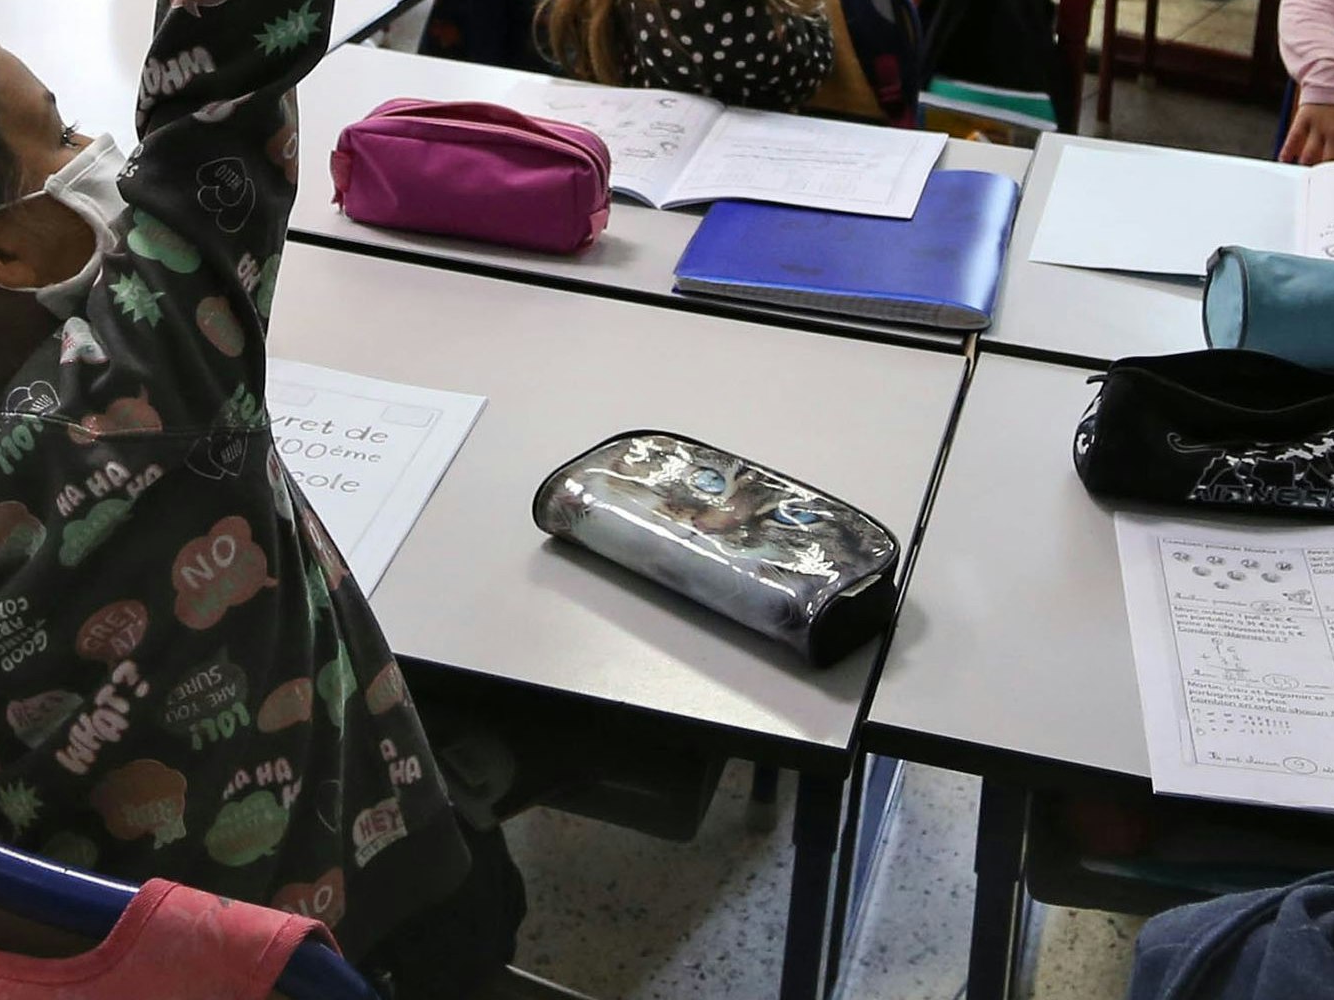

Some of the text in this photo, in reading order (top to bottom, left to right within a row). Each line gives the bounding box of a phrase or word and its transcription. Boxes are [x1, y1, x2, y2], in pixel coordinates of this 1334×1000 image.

[345, 425, 388, 444] de
[180, 534, 236, 590] NO
[255, 757, 293, 786] HA
[388, 754, 423, 786] HA
